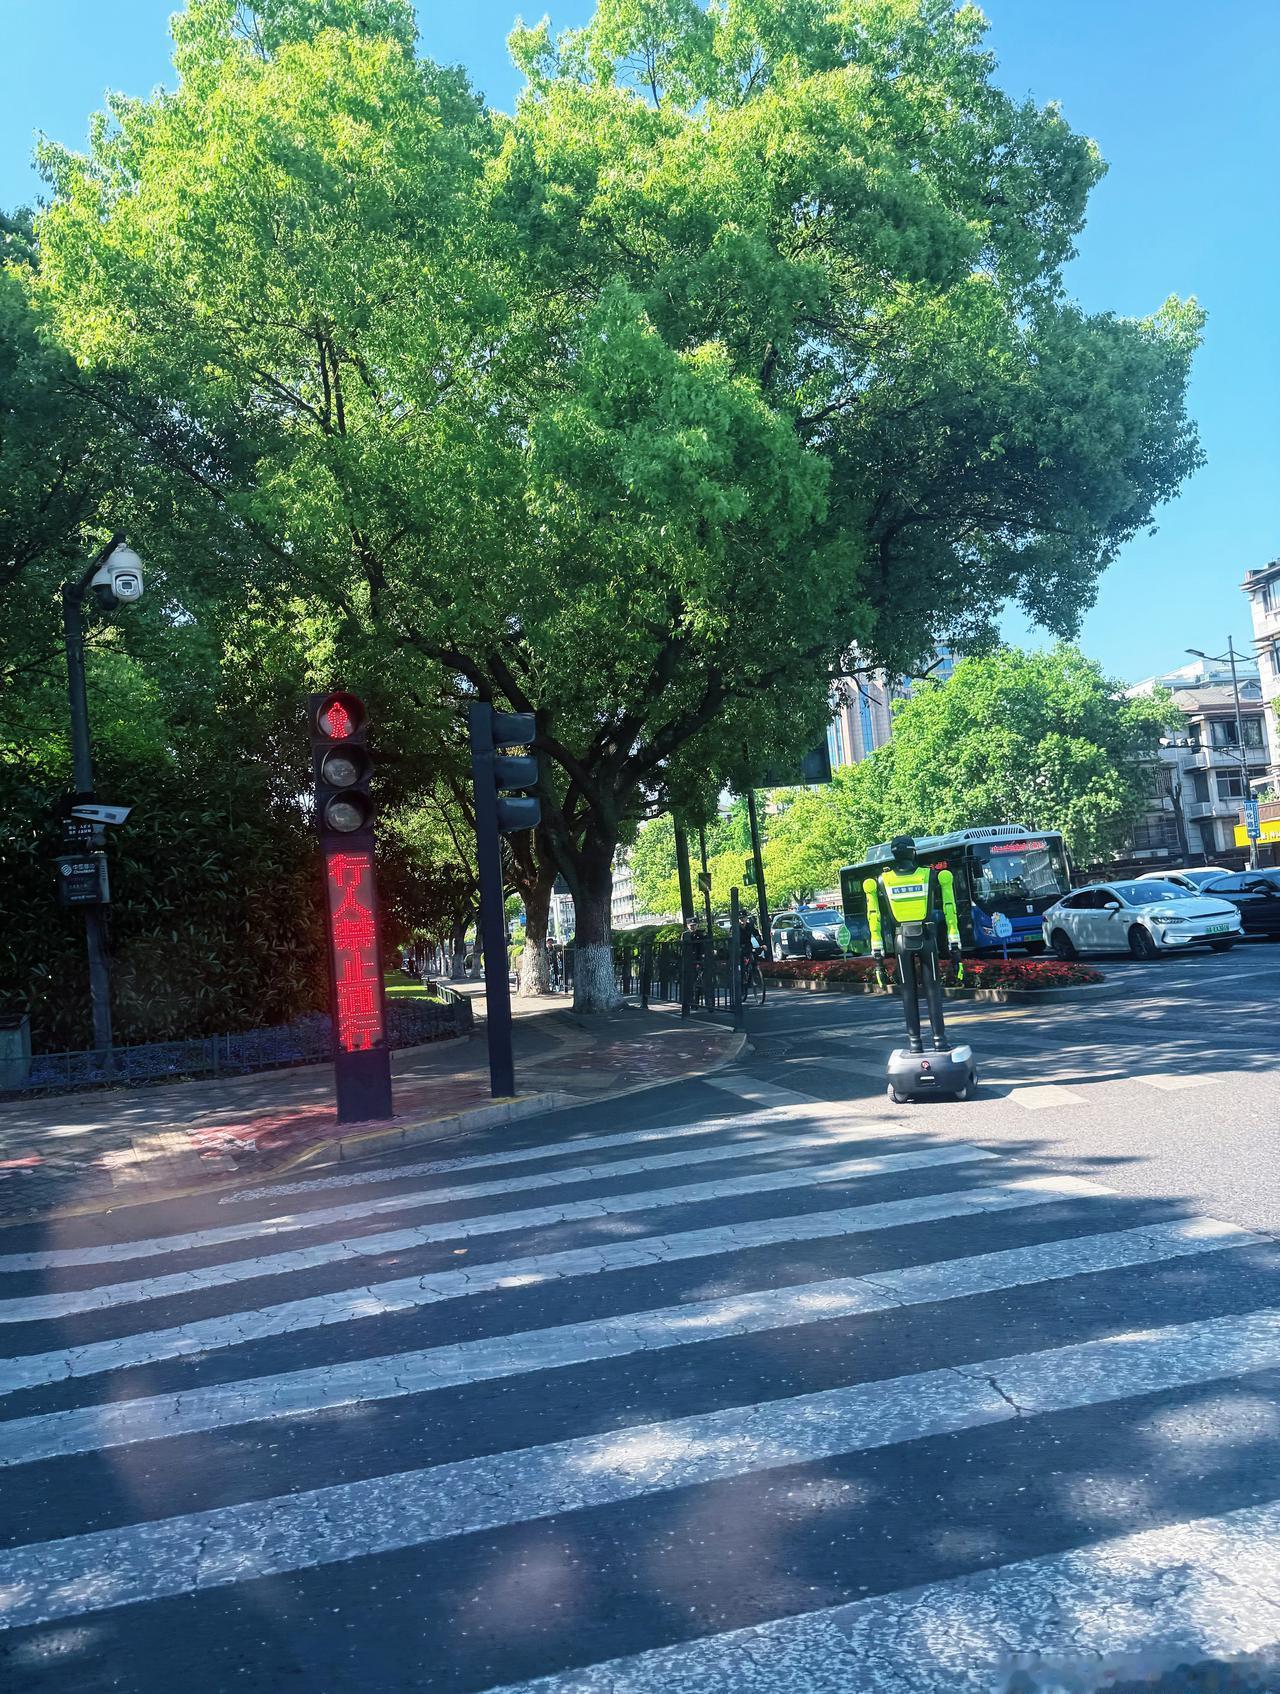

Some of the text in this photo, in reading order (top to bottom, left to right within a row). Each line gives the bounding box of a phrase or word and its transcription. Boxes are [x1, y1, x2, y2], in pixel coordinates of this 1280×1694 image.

[328, 853, 381, 1053] 行人禁止通行
